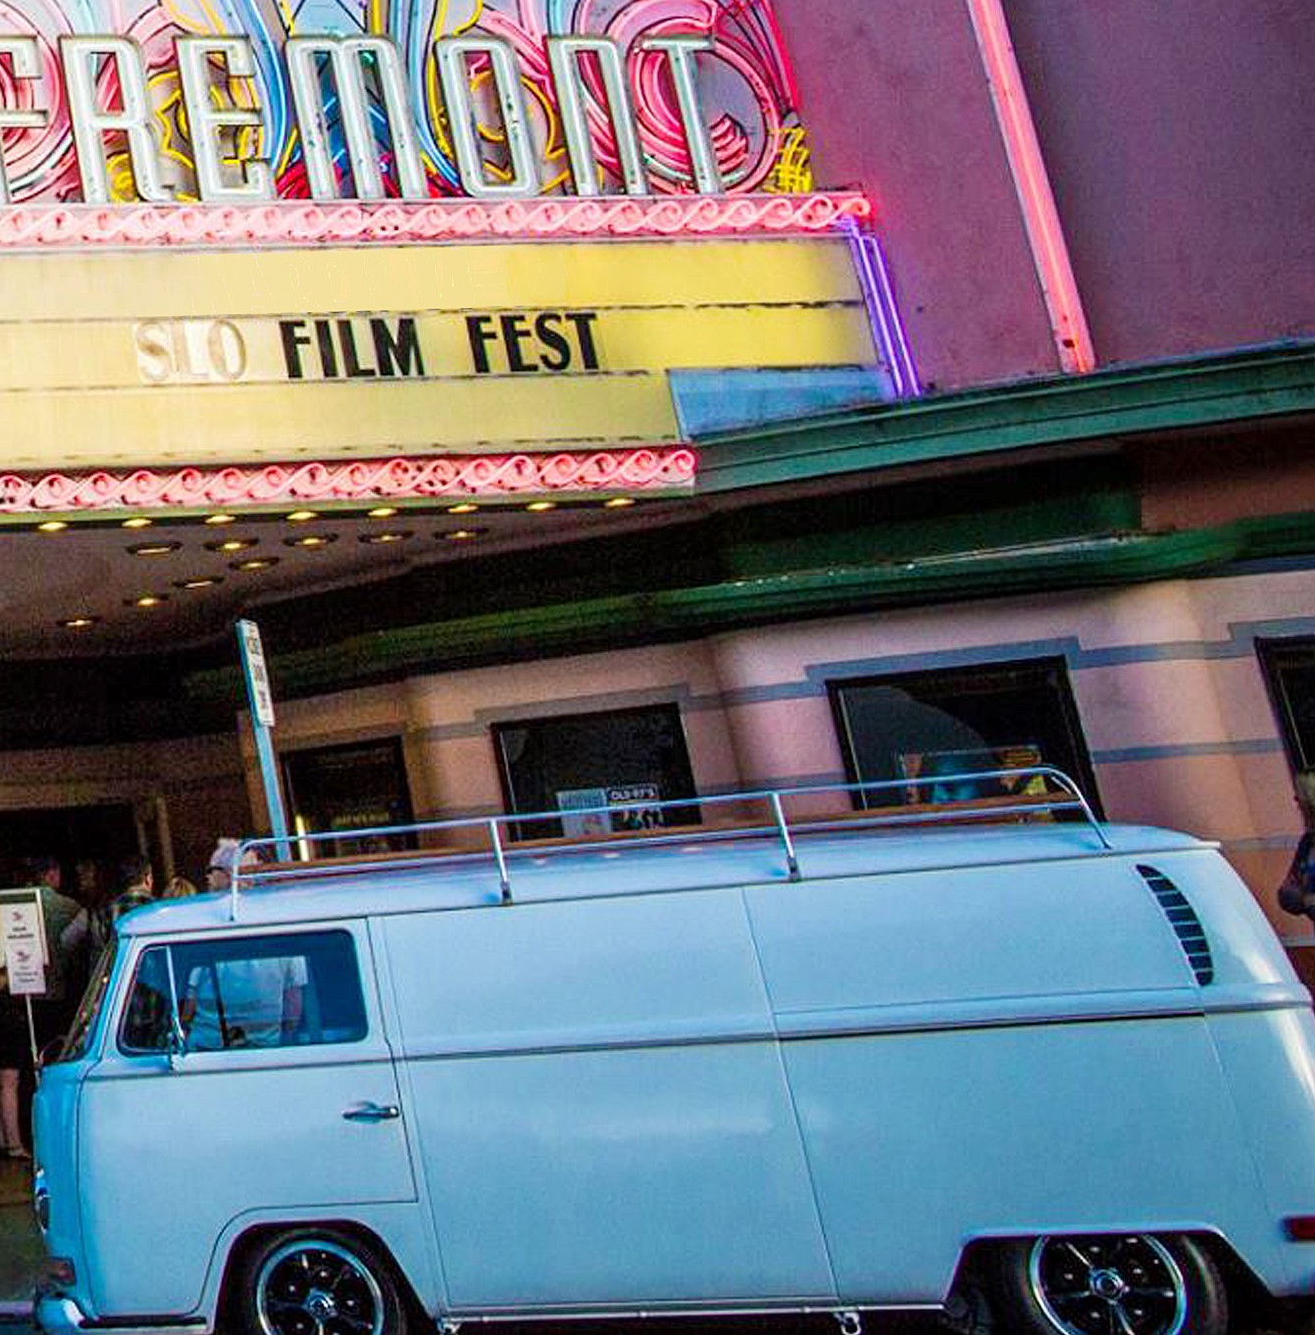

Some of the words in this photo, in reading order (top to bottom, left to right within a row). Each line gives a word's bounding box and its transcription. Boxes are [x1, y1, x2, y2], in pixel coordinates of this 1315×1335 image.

[134, 319, 248, 382] SLO
[278, 317, 425, 379] FILM
[467, 311, 601, 375] FEST
